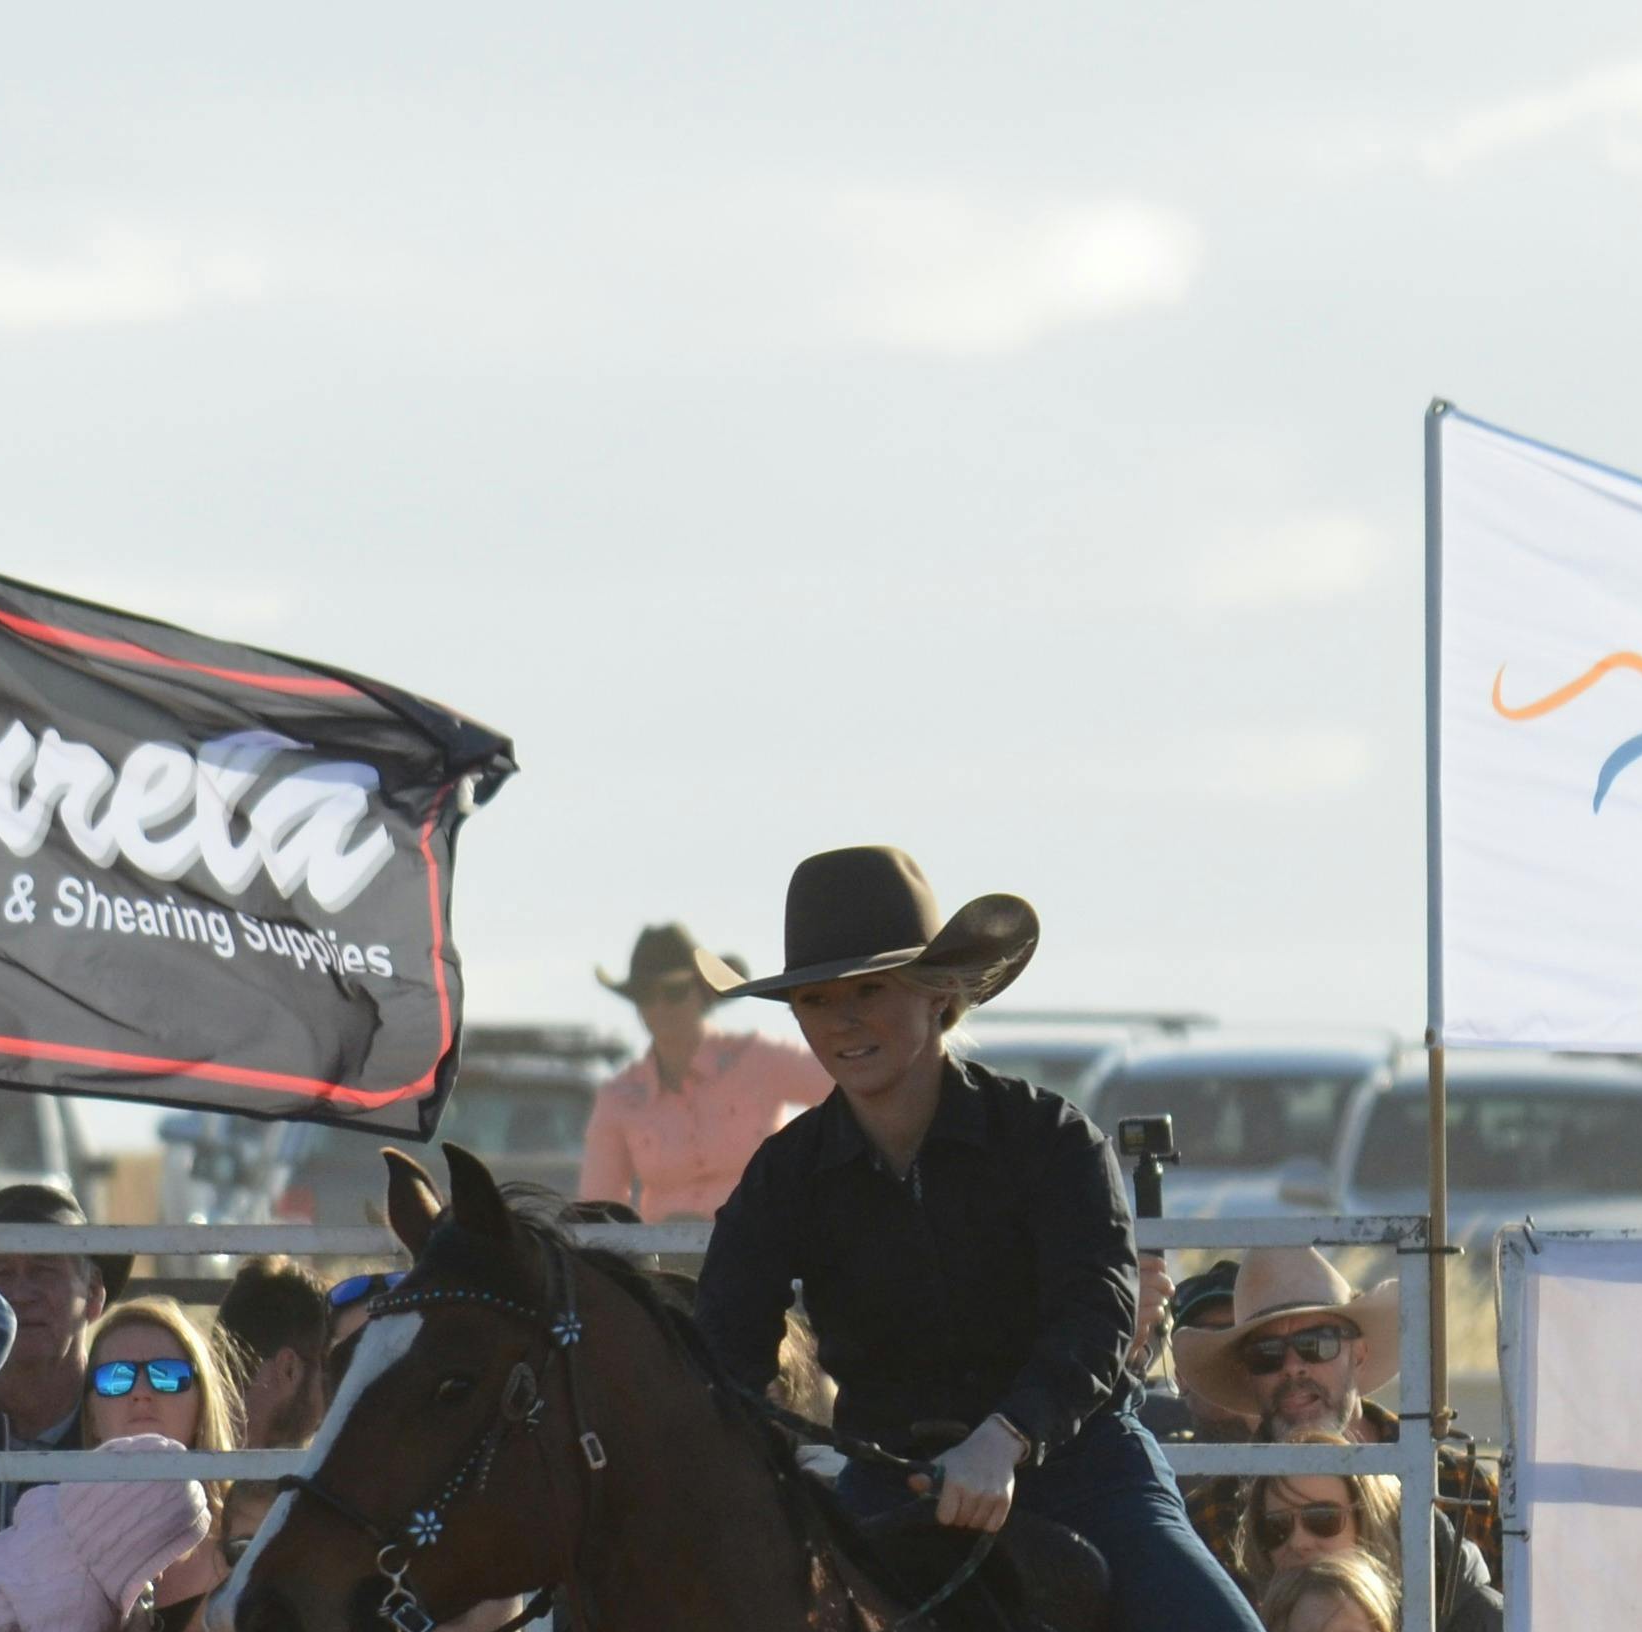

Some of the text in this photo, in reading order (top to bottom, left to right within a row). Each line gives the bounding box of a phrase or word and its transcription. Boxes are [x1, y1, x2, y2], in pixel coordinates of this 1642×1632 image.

[2, 871, 38, 925] &
[51, 875, 236, 959] Shearing
[236, 911, 394, 978] Supplies
